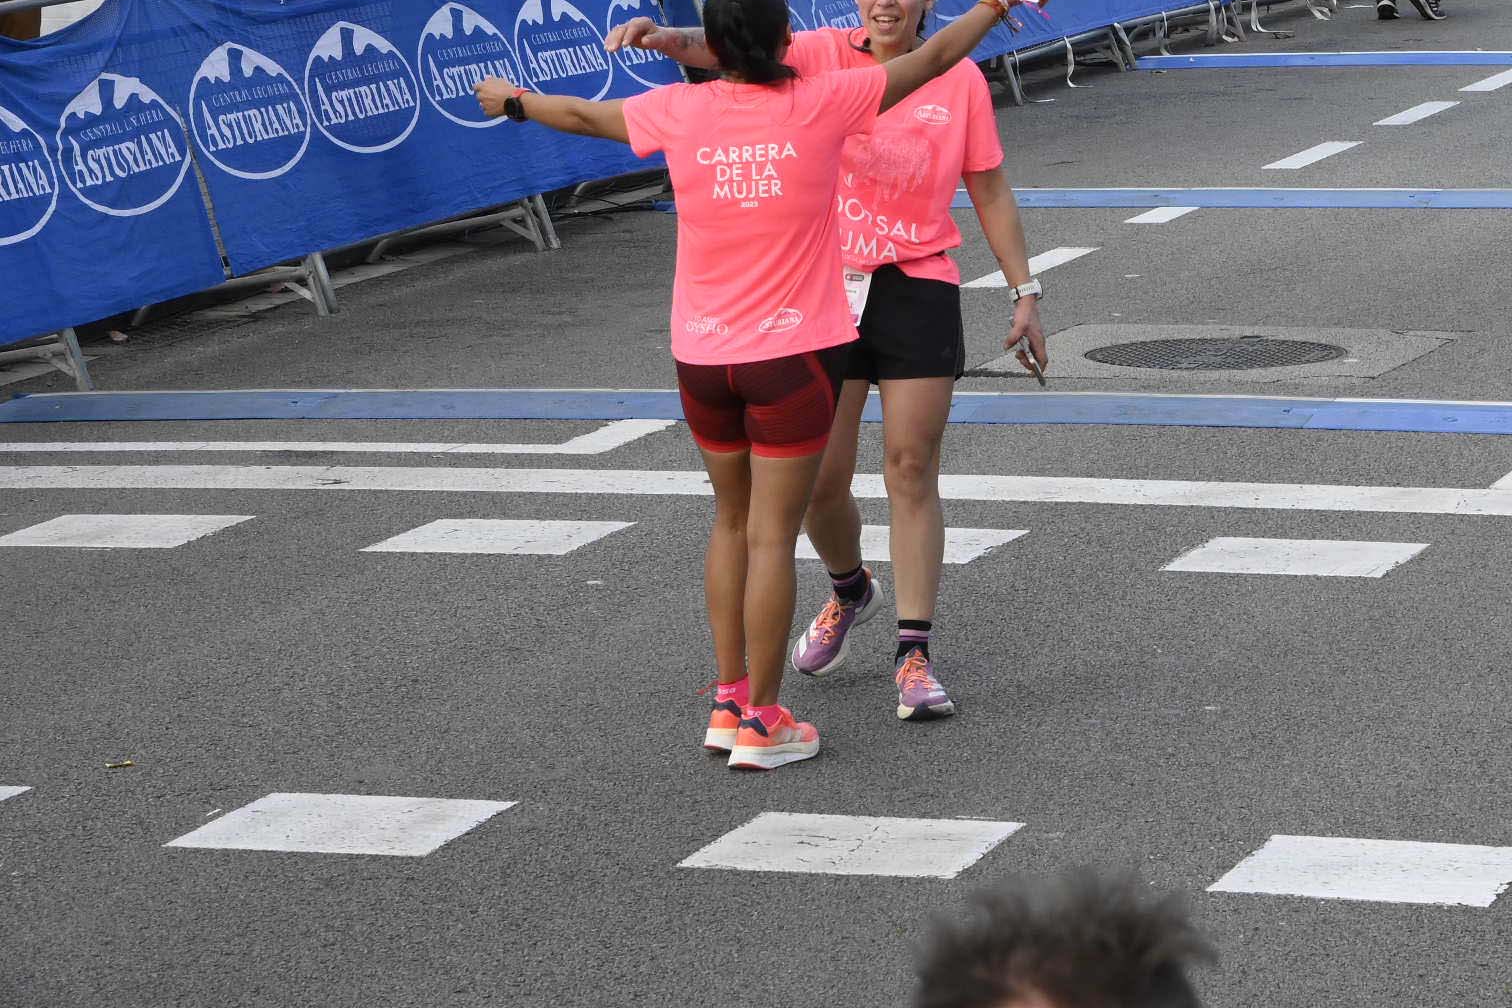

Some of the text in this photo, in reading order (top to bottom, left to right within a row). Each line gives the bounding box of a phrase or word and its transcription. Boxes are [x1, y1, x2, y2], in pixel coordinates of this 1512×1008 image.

[437, 45, 471, 60] CENTRAL
[522, 39, 608, 83] ASTURIANA
[325, 58, 400, 85] CENTRAL LECHERA
[213, 82, 290, 108] CENTRAL LECHERA
[315, 76, 416, 127] ASTURIANA
[80, 123, 123, 142] CENTRAL
[201, 99, 305, 152] ASTURIANA
[1, 137, 34, 155] ECHERA
[696, 142, 797, 164] CARRERA
[716, 162, 777, 182] DE LA
[712, 179, 783, 200] MUJER
[839, 228, 898, 262] UMA
